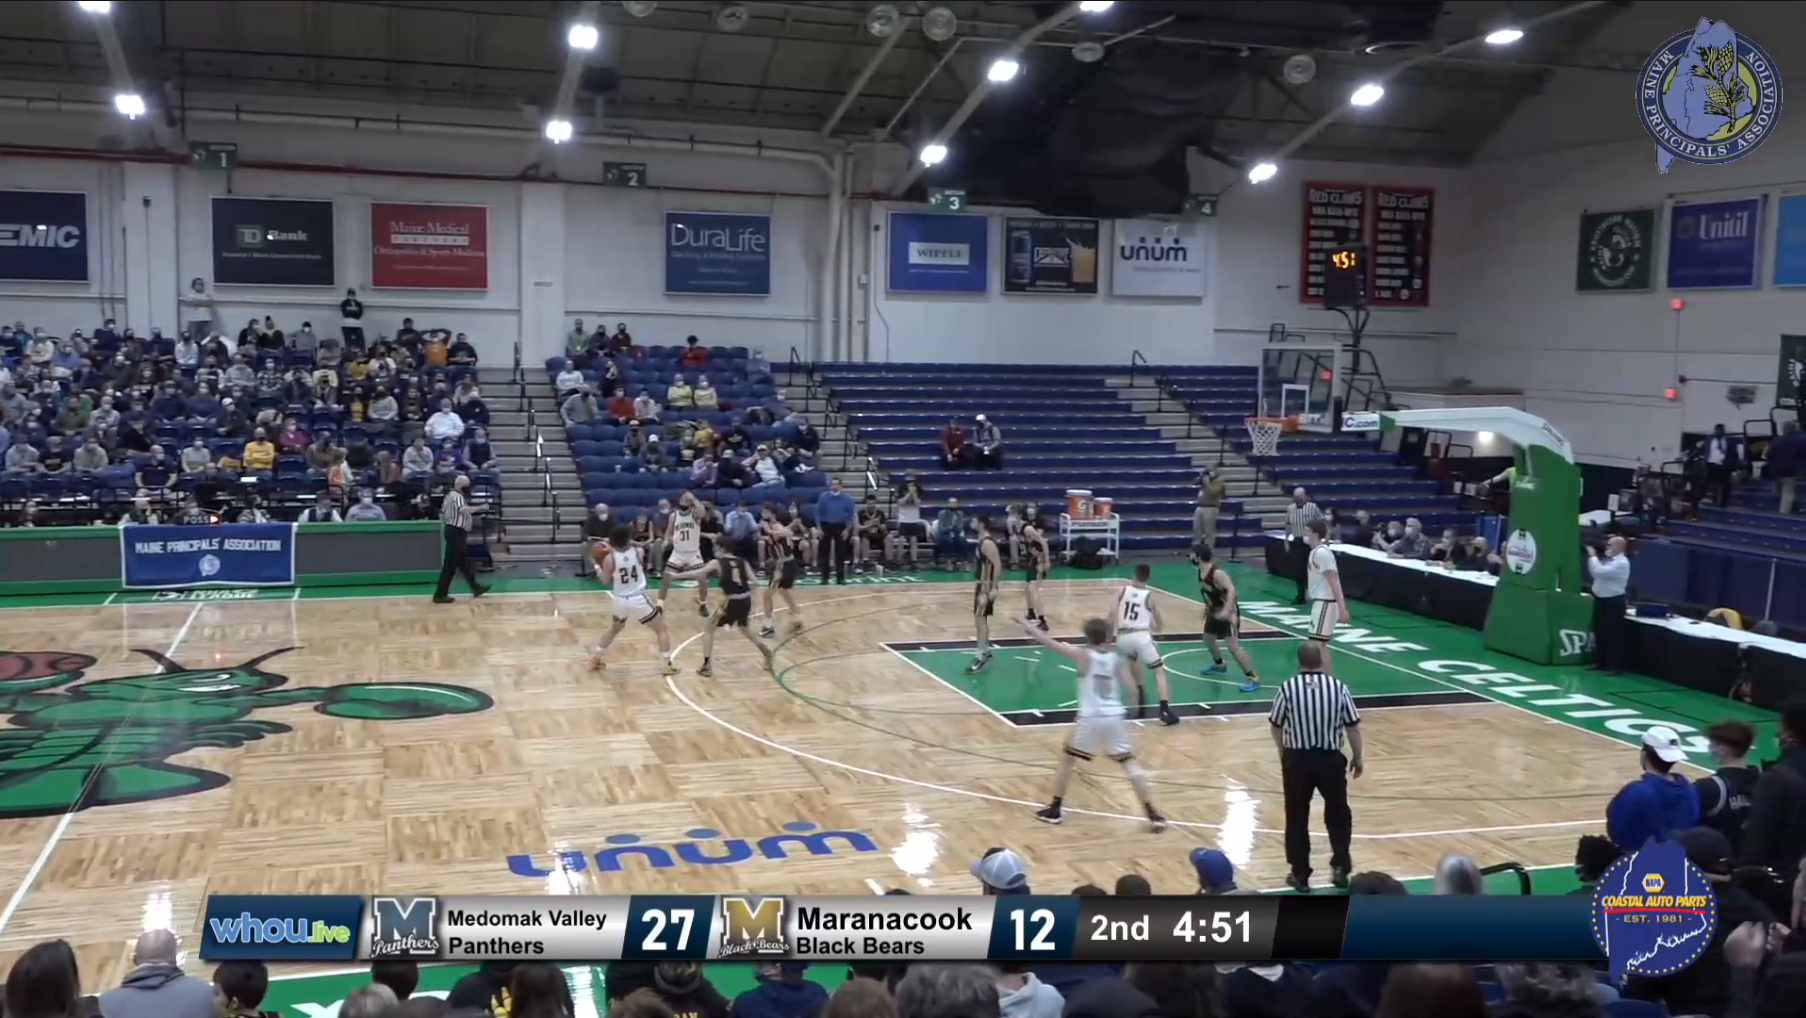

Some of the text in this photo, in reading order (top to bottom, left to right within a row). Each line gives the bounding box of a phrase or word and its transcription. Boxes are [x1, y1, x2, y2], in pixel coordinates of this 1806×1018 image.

[218, 152, 226, 167] 1
[628, 172, 638, 186] 2
[949, 197, 959, 210] 3
[1201, 203, 1211, 214] 4
[427, 223, 469, 234] Medical
[1700, 211, 1749, 239] Unitil
[237, 229, 308, 243] TD Bank
[672, 223, 765, 252] DuraLife
[1121, 236, 1187, 262] unum
[183, 516, 208, 524] POSS
[680, 530, 690, 541] 31
[135, 542, 164, 554] MAINE
[223, 539, 281, 551] ASSOCIATION
[619, 565, 638, 584] 24
[1123, 601, 1140, 621] 15
[507, 821, 879, 877] unum
